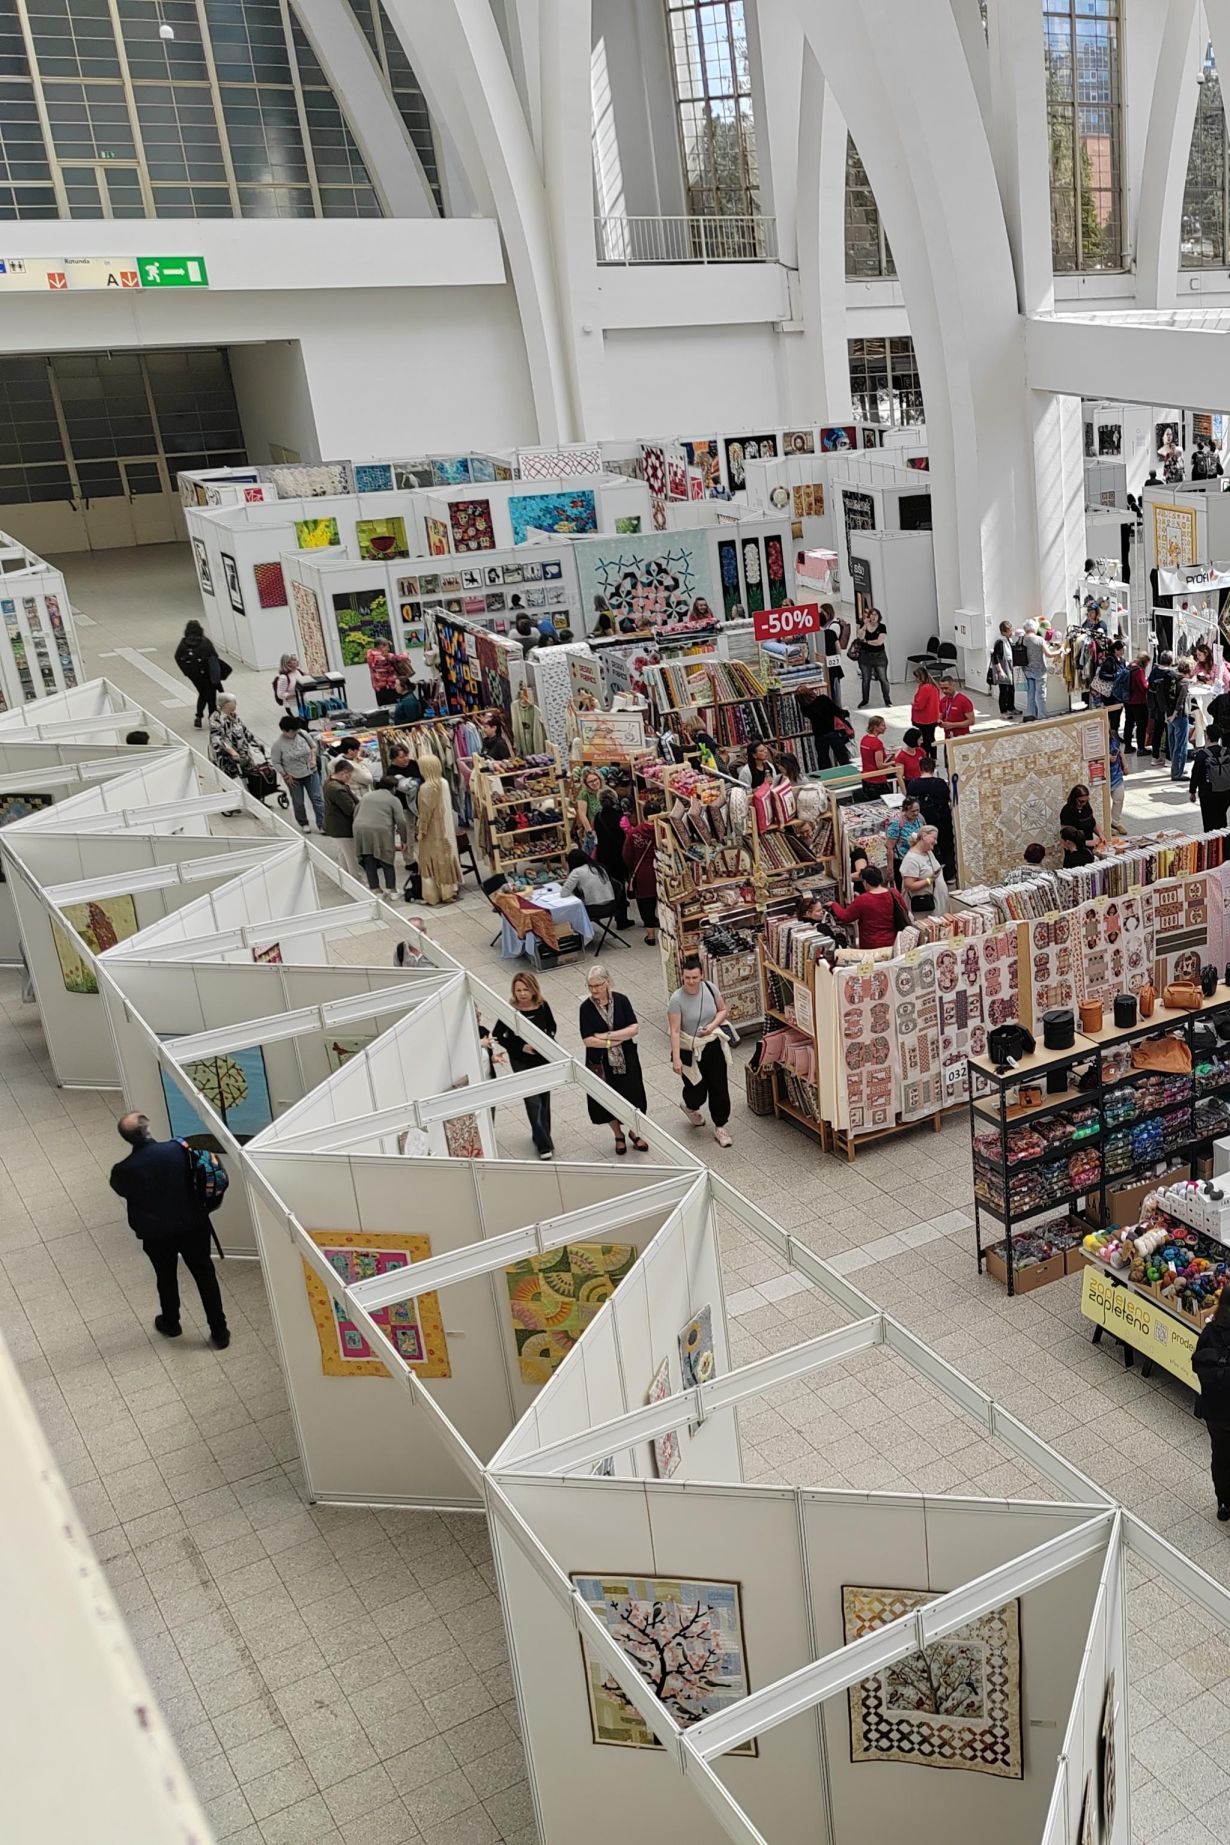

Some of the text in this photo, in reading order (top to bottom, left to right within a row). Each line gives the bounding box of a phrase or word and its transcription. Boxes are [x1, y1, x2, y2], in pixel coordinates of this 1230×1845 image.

[107, 273, 119, 286] A
[761, 608, 814, 633] -50%
[949, 1067, 967, 1082] 032
[1088, 1288, 1150, 1335] zapleteno
